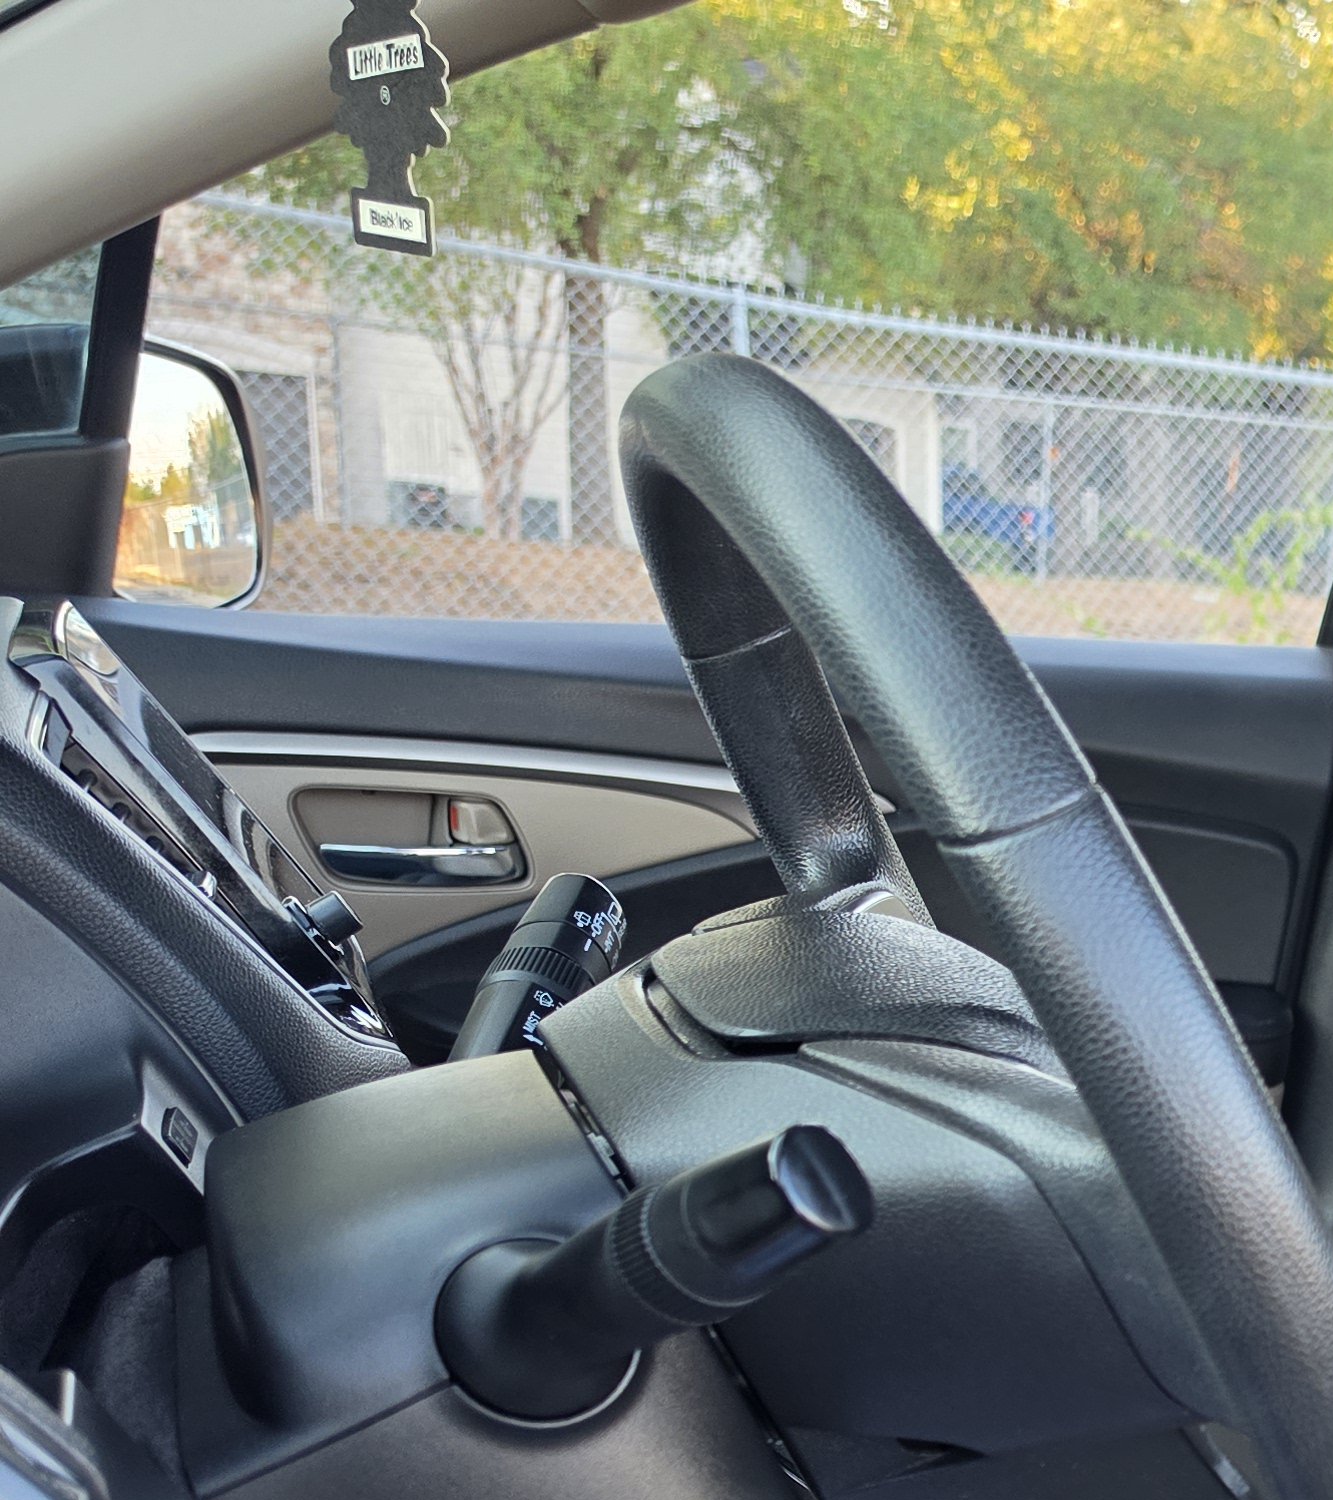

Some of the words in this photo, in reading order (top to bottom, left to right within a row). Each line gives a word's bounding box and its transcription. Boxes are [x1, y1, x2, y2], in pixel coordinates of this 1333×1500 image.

[353, 47, 383, 76] Little
[385, 43, 419, 69] Trees
[369, 208, 395, 228] Black
[399, 218, 414, 232] Ice
[590, 912, 604, 934] OFF
[602, 931, 614, 950] INT
[522, 1010, 541, 1032] MIST
